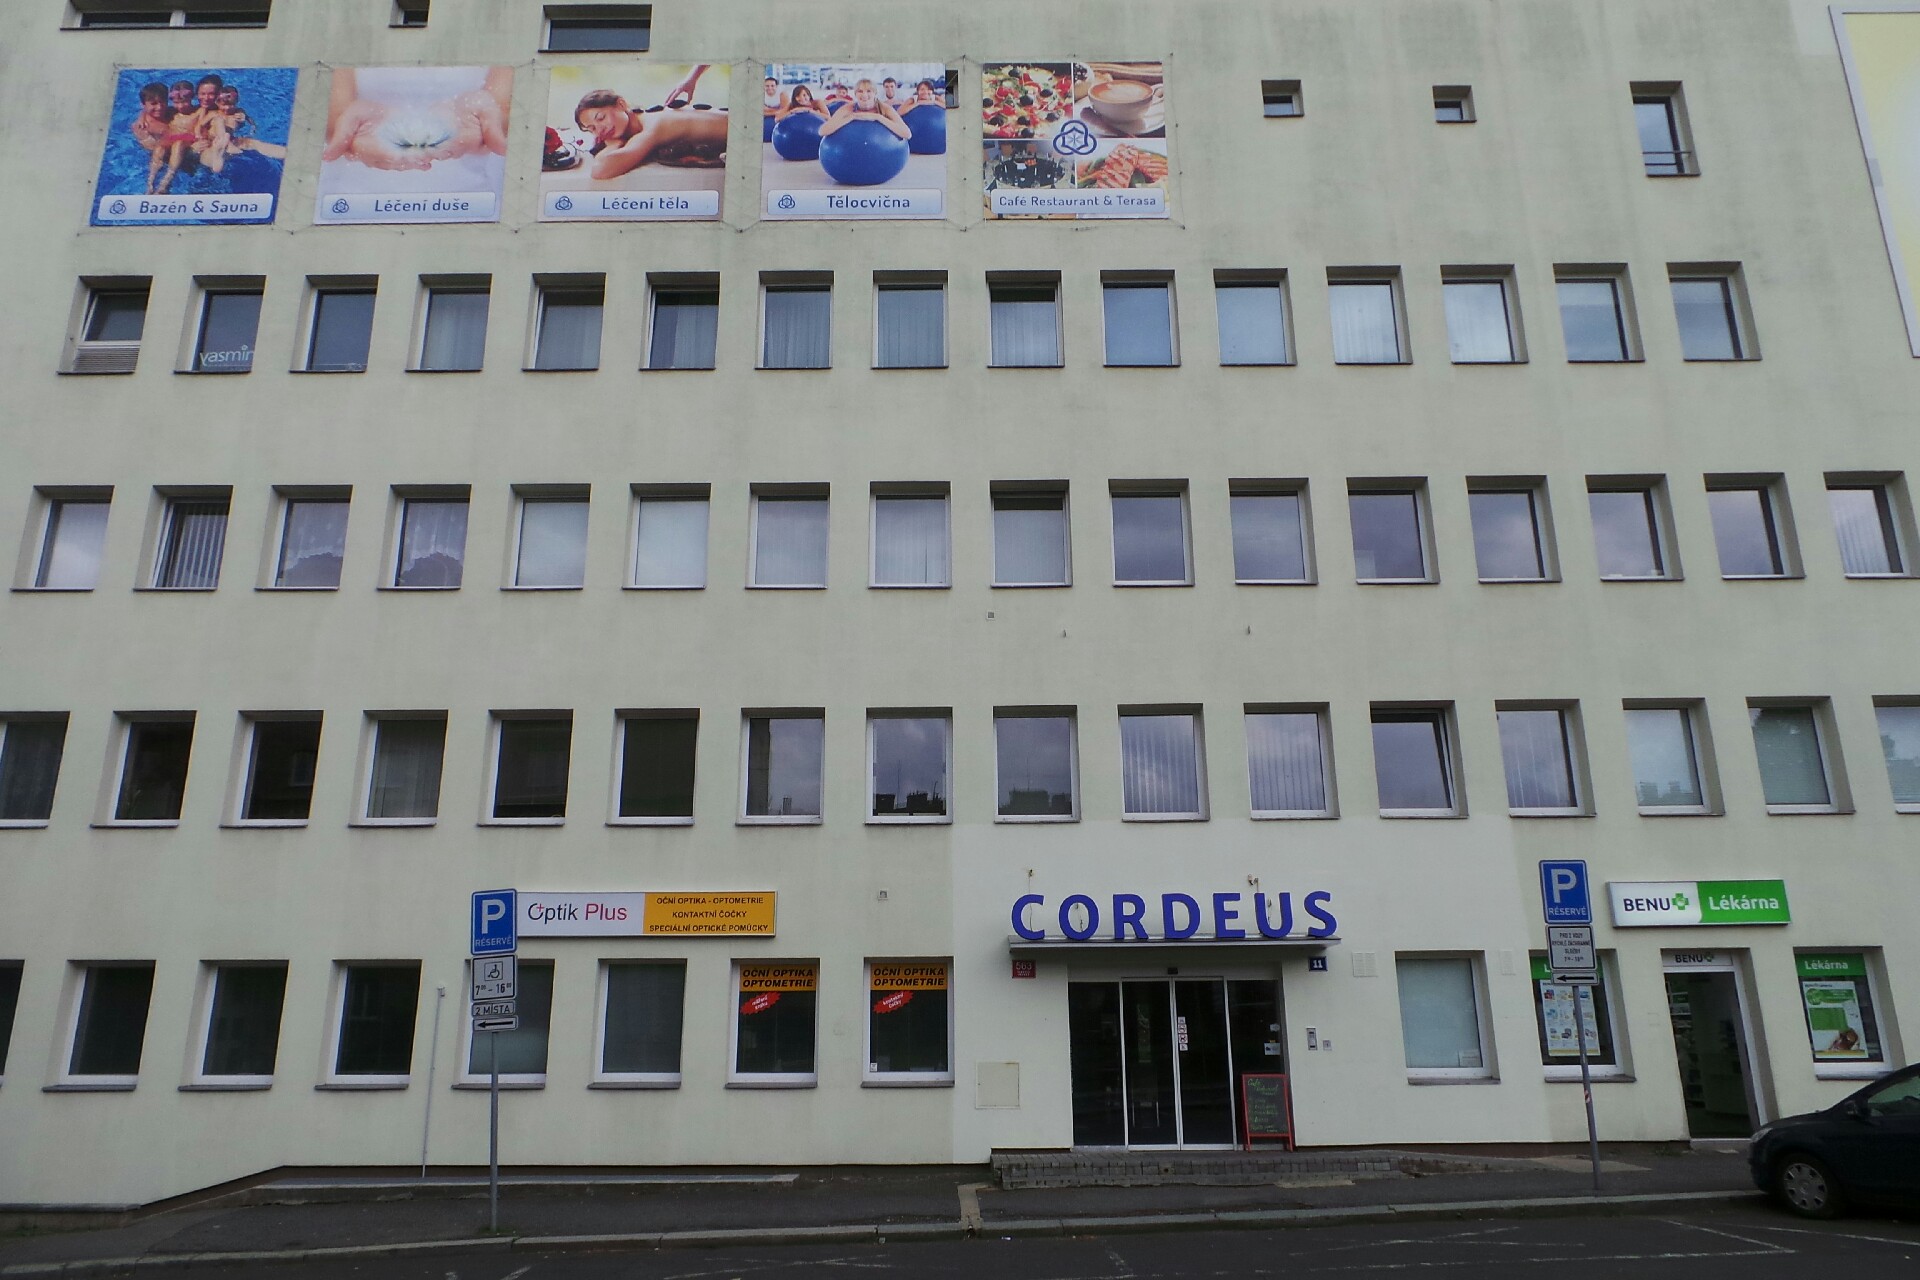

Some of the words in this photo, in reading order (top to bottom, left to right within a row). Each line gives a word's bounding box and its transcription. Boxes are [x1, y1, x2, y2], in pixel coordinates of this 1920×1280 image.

[140, 201, 186, 214] Bazén
[192, 200, 204, 213] &
[210, 200, 258, 213] Sauna
[374, 199, 427, 212] Léčení
[432, 198, 469, 211] duše
[602, 197, 653, 210] Léčení
[659, 196, 689, 210] těla
[826, 195, 910, 208] Tělocvična
[999, 196, 1026, 206] Café
[1031, 196, 1100, 206] Restaurant
[1104, 196, 1112, 206] &
[1116, 196, 1156, 206] Terasa
[1551, 869, 1576, 903] P
[1624, 898, 1670, 912] BENU
[1708, 894, 1779, 910] Lékárna
[481, 899, 506, 934] P
[528, 902, 578, 924] Optik
[585, 903, 627, 921] Plus
[1010, 890, 1337, 940] CORDEUS
[1548, 906, 1587, 916] RÉSERVÉ
[475, 936, 512, 947] RÉSERVÉ
[1313, 960, 1323, 968] 11
[1675, 954, 1703, 963] BENU
[874, 966, 900, 976] OČNÍ
[1805, 960, 1848, 970] Lékárna
[743, 968, 770, 977] OČNÍ
[484, 1004, 510, 1014] MÍSTA
